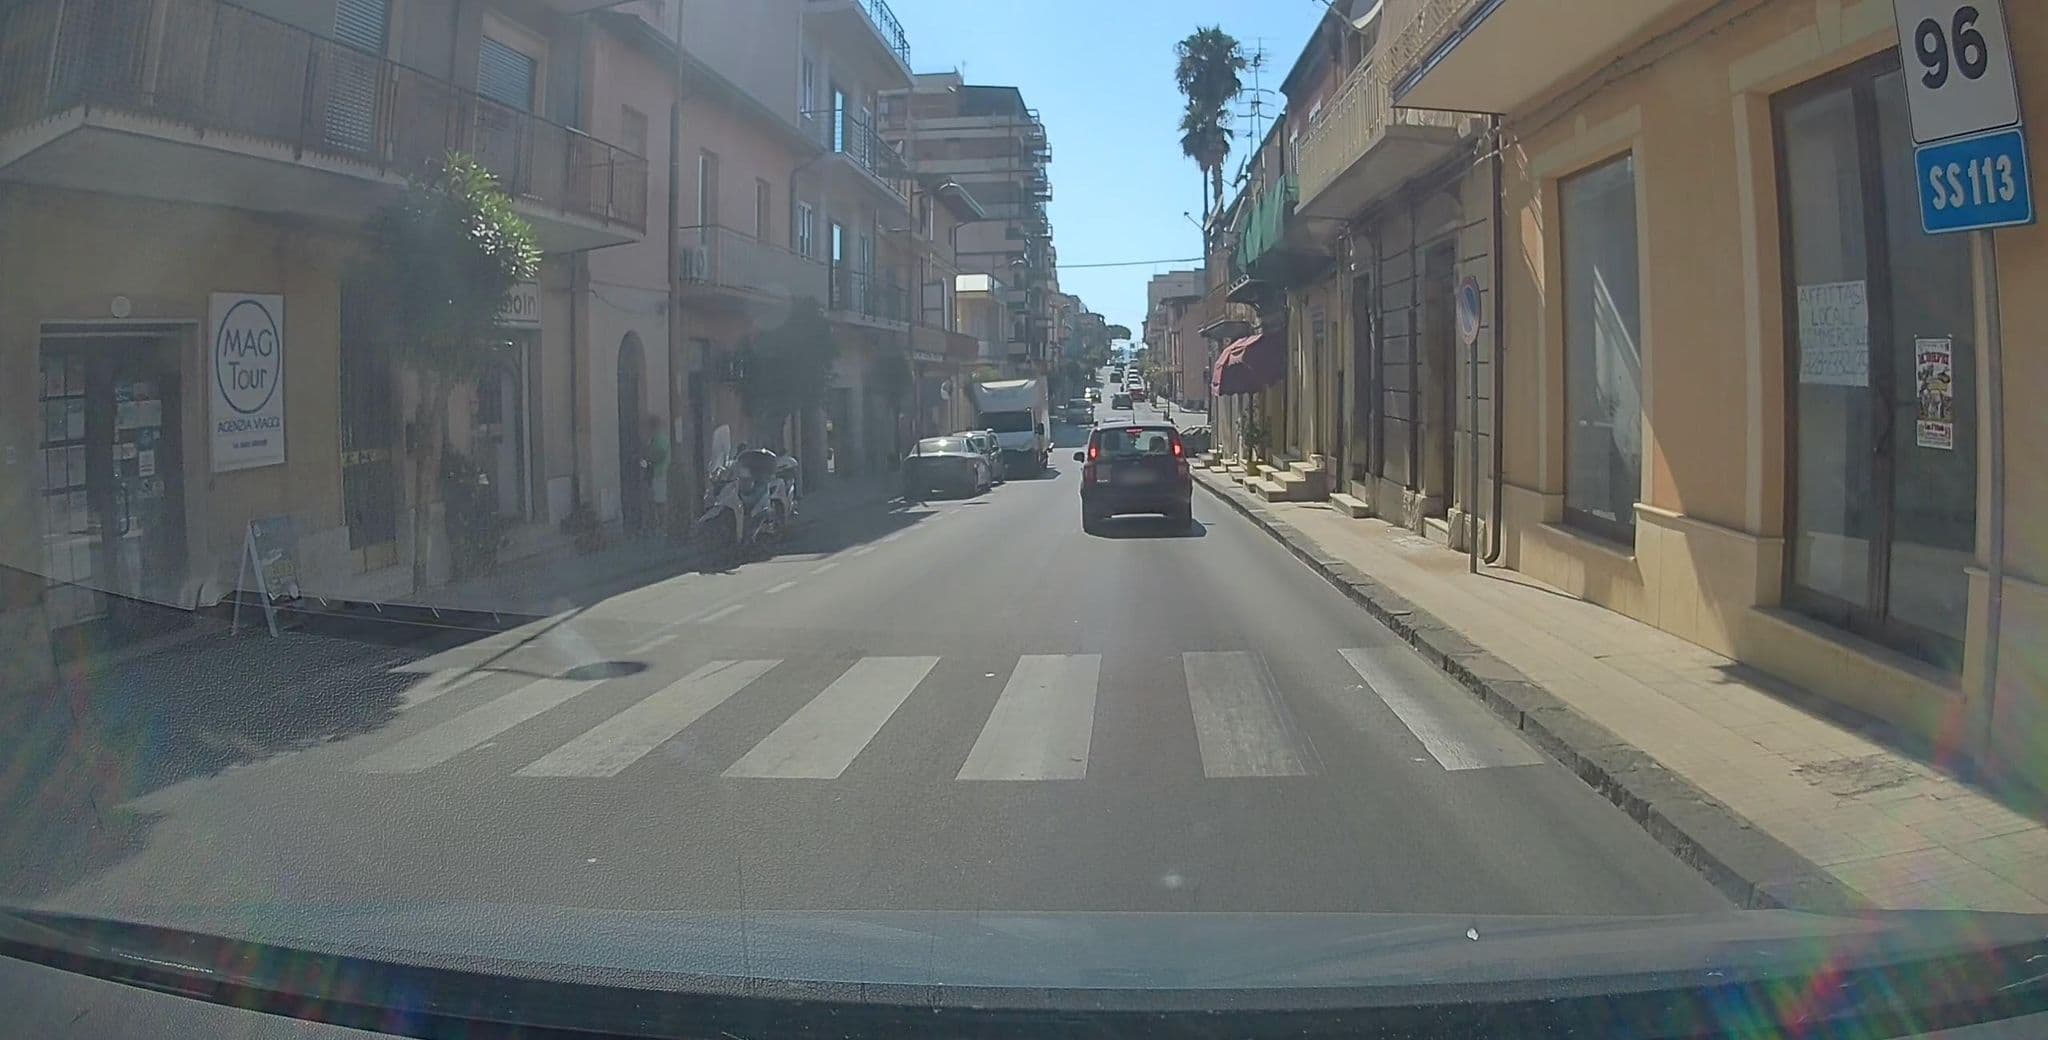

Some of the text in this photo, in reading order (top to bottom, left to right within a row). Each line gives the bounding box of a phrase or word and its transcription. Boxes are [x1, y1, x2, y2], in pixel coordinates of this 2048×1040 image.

[1914, 6, 1988, 90] 96
[223, 328, 273, 359] MAG
[228, 360, 268, 391] Tour
[217, 418, 252, 433] AGENZIA
